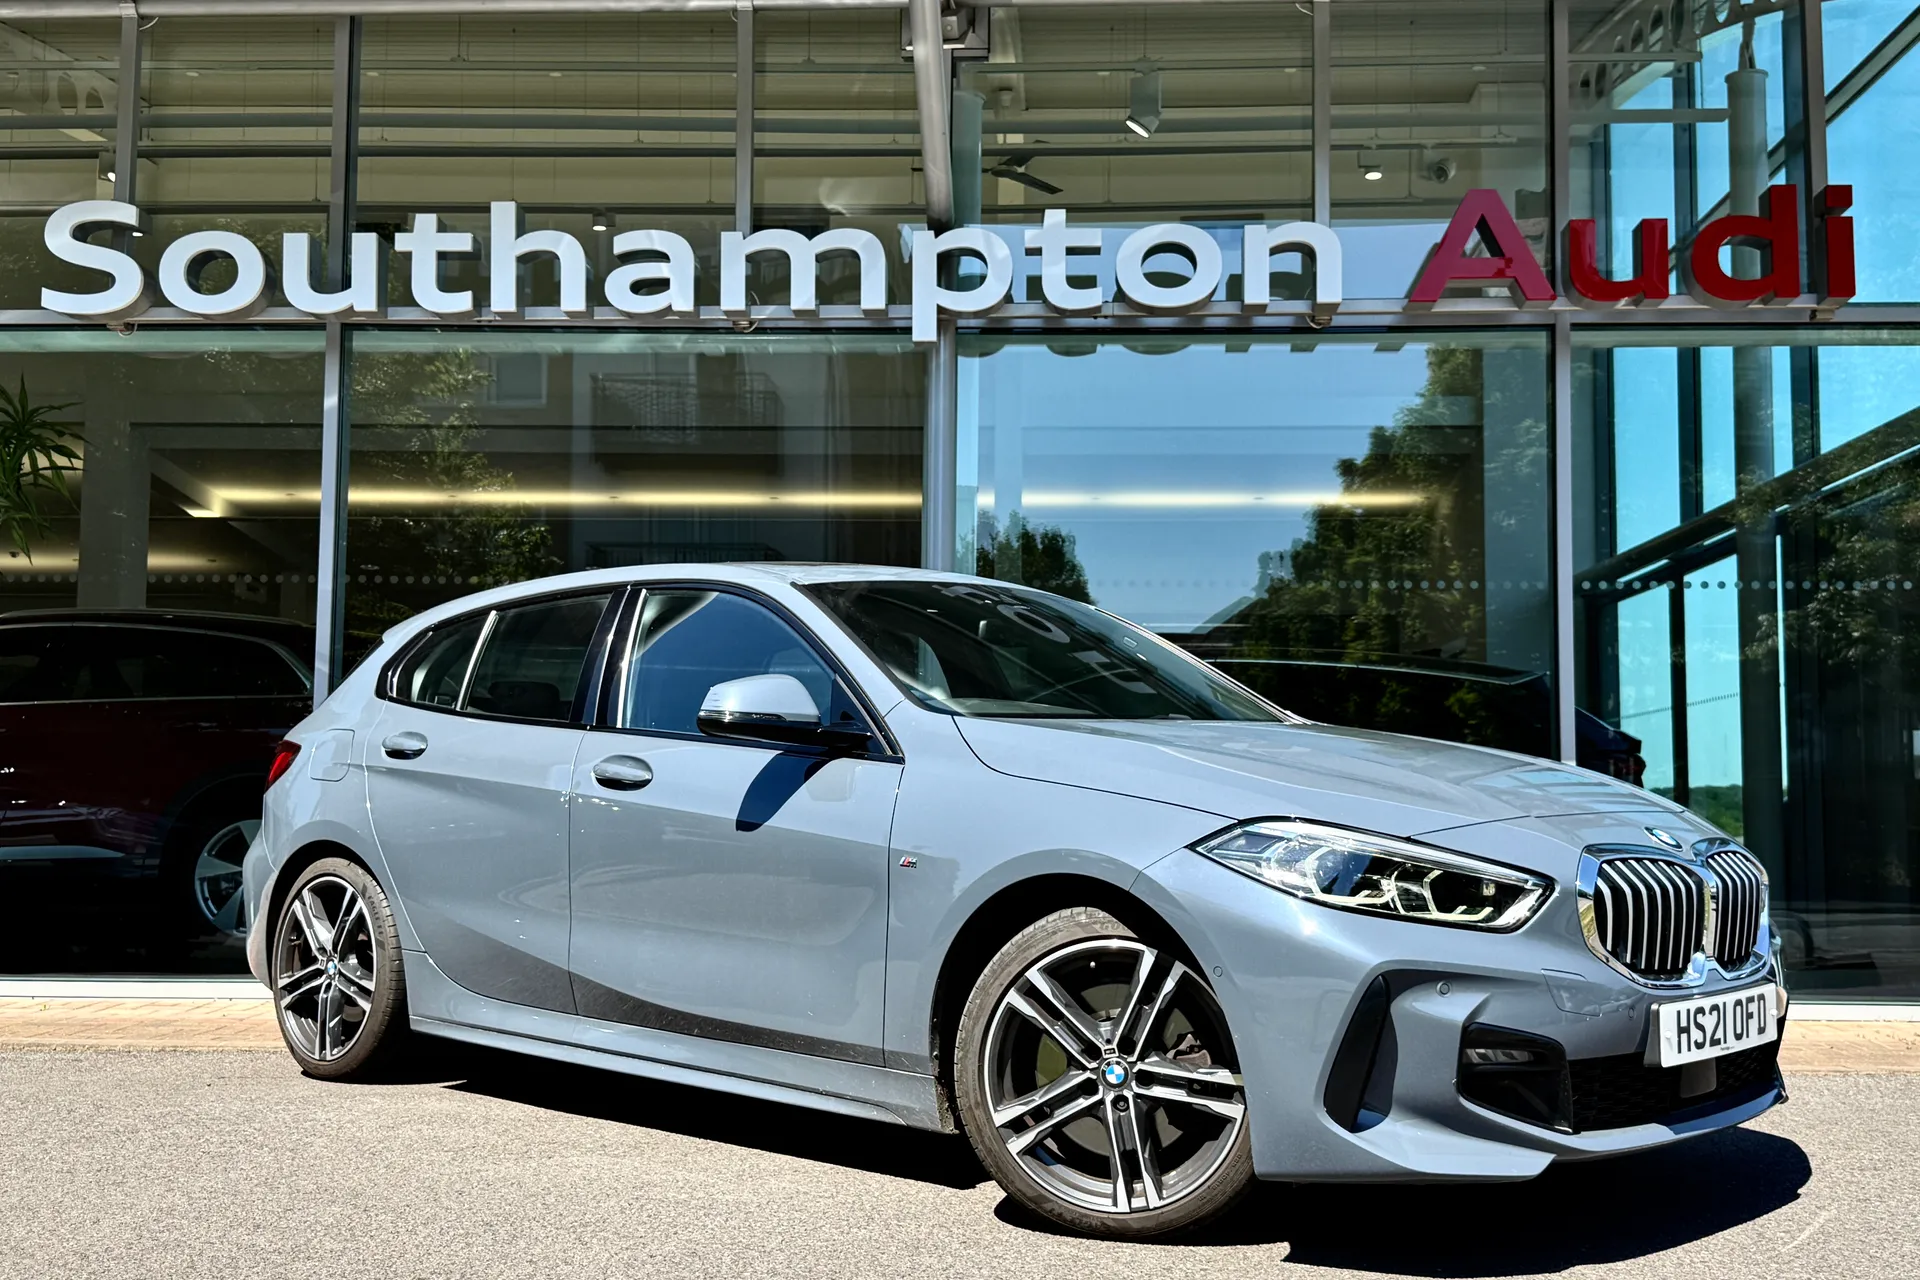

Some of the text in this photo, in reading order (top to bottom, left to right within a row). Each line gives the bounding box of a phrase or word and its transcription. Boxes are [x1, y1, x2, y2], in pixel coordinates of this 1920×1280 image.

[41, 184, 1856, 342] Southampton Audi
[1676, 992, 1767, 1054] HS21 OFD
